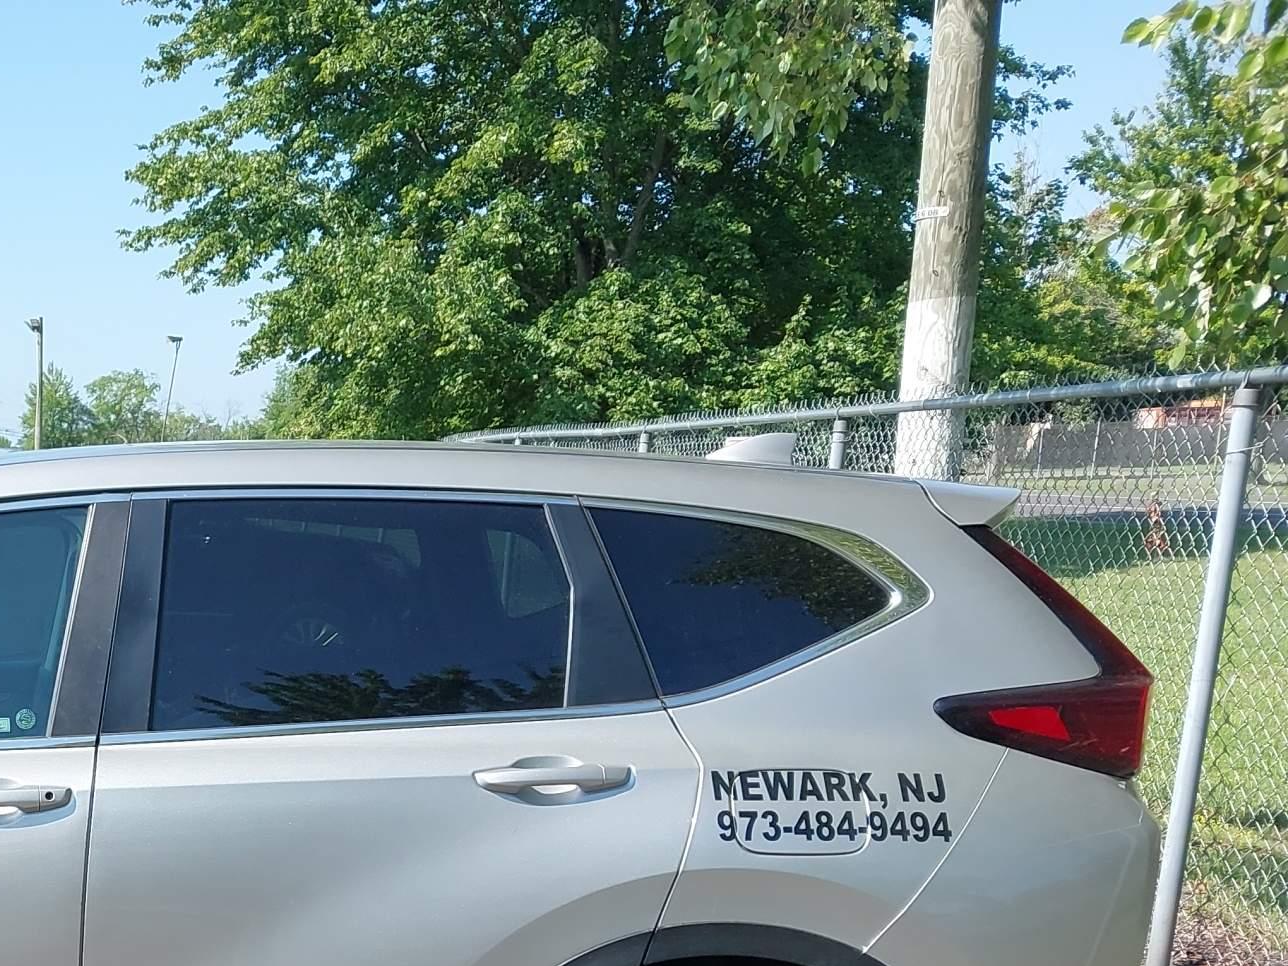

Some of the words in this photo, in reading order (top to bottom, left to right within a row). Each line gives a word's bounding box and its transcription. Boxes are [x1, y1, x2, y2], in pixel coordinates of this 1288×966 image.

[710, 770, 888, 810] NEWARK,
[897, 772, 946, 803] NJ
[716, 810, 953, 843] 973-484-9494
